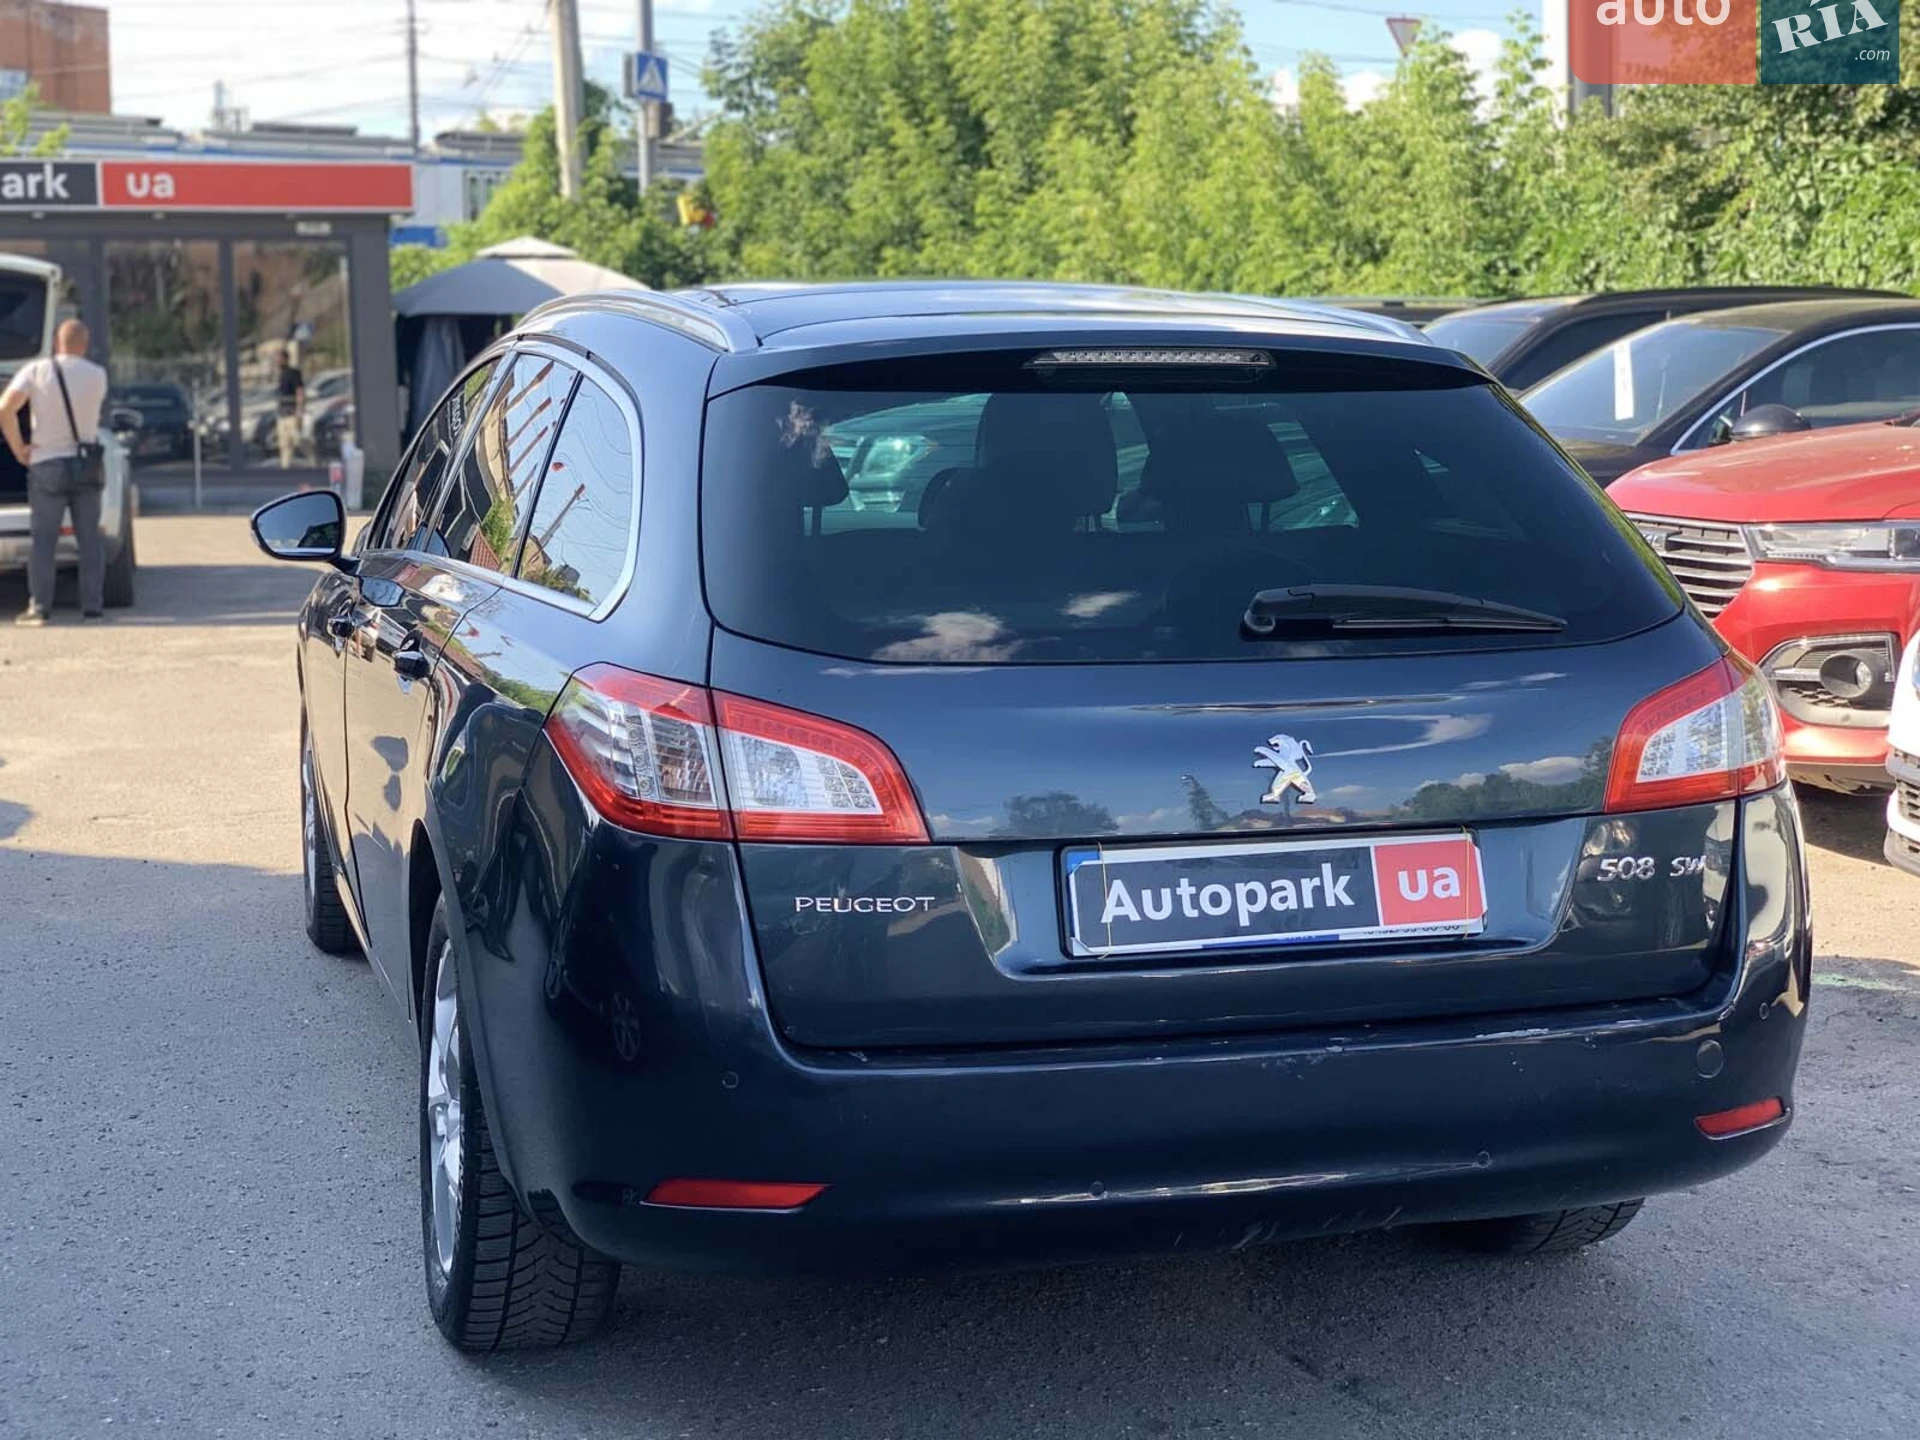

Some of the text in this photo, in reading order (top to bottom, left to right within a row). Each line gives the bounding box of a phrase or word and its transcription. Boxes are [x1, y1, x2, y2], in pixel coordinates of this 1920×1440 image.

[126, 172, 176, 199] ua
[1597, 855, 1707, 882] 508 SW
[795, 896, 936, 913] PEUGEOT
[1101, 863, 1461, 926] Autopark ua
